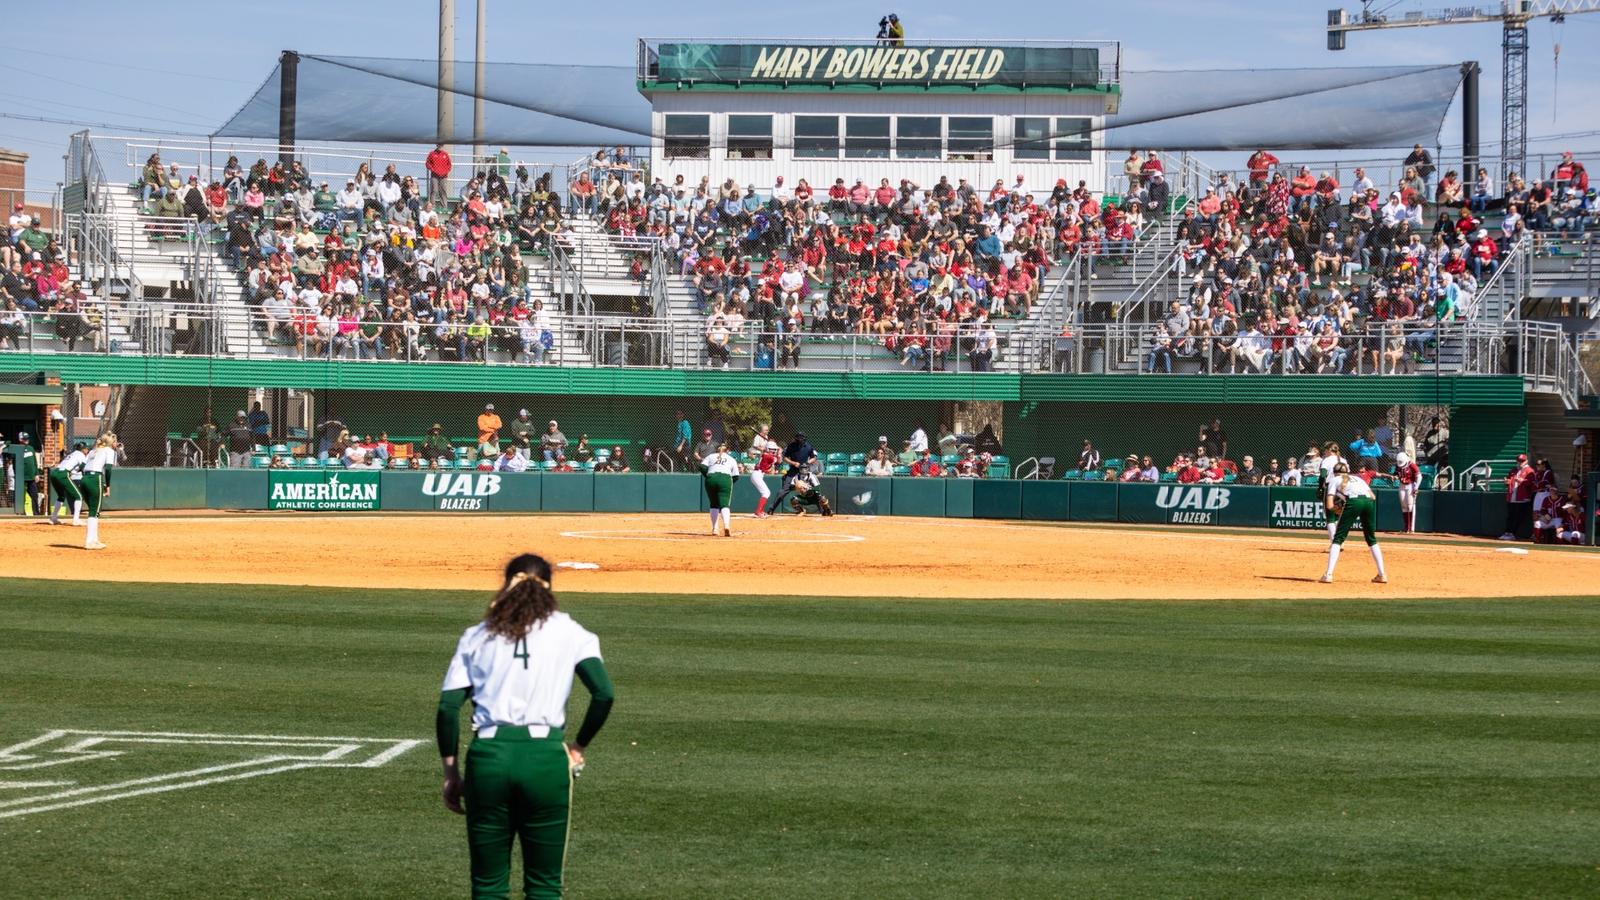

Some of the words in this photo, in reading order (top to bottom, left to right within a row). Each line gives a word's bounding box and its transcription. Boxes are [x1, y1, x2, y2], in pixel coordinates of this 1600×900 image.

[752, 47, 824, 78] MARY
[824, 48, 932, 80] BOWERS
[934, 50, 1005, 80] FIELD
[271, 479, 378, 500] AMERICAN
[422, 474, 502, 496] UAB
[440, 499, 481, 510] BLAZERS
[1155, 486, 1230, 509] UAB
[1172, 512, 1211, 524] BLAZERS
[1272, 501, 1327, 519] AMER
